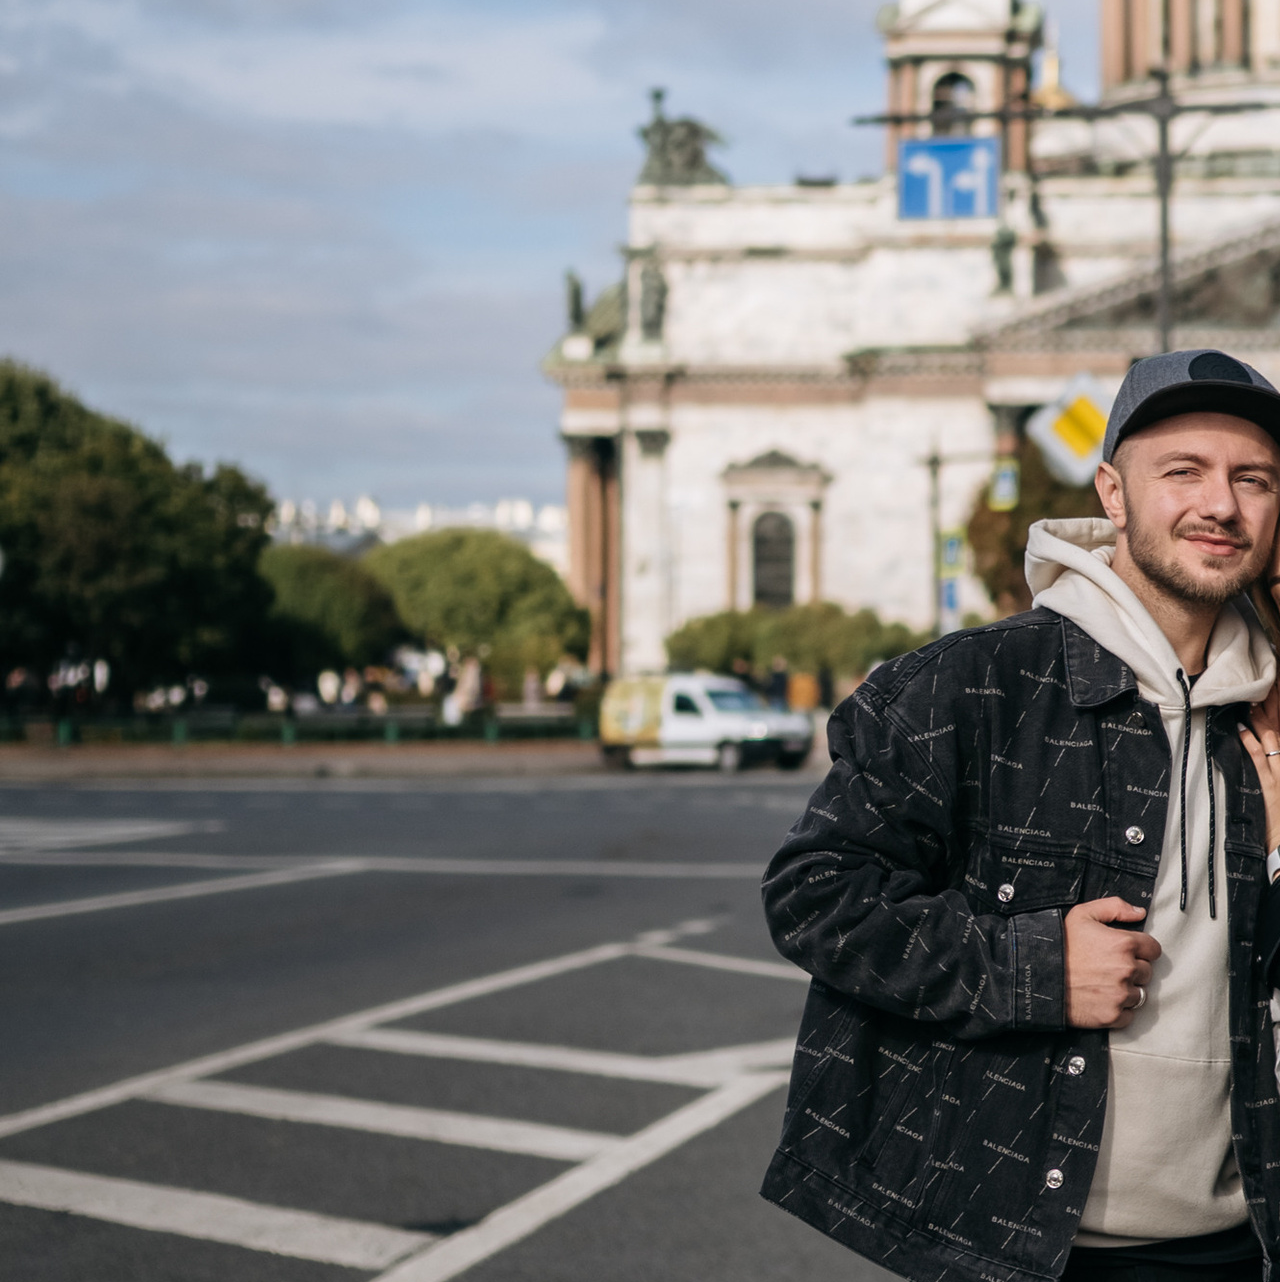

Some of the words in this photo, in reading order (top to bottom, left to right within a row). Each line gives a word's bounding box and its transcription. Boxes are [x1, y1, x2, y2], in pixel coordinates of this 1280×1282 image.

[908, 723, 956, 743] ALENCIAG
[991, 753, 1023, 770] ENCIAGA
[1127, 785, 1169, 798] BALENCIA
[997, 824, 1051, 838] BALENCIAGA
[1002, 856, 1055, 868] BALENCIAGA
[808, 870, 837, 884] BALEN
[962, 915, 975, 944] BALEN
[824, 1046, 855, 1064] ENCIAGA
[805, 1107, 850, 1139] BALENCIAGA
[982, 1139, 1030, 1164] BALENCIAGA
[1052, 1133, 1099, 1152] BALENCIAG
[827, 1198, 876, 1229] BALENCIAGA
[928, 1223, 973, 1246] BALENCIAGA
